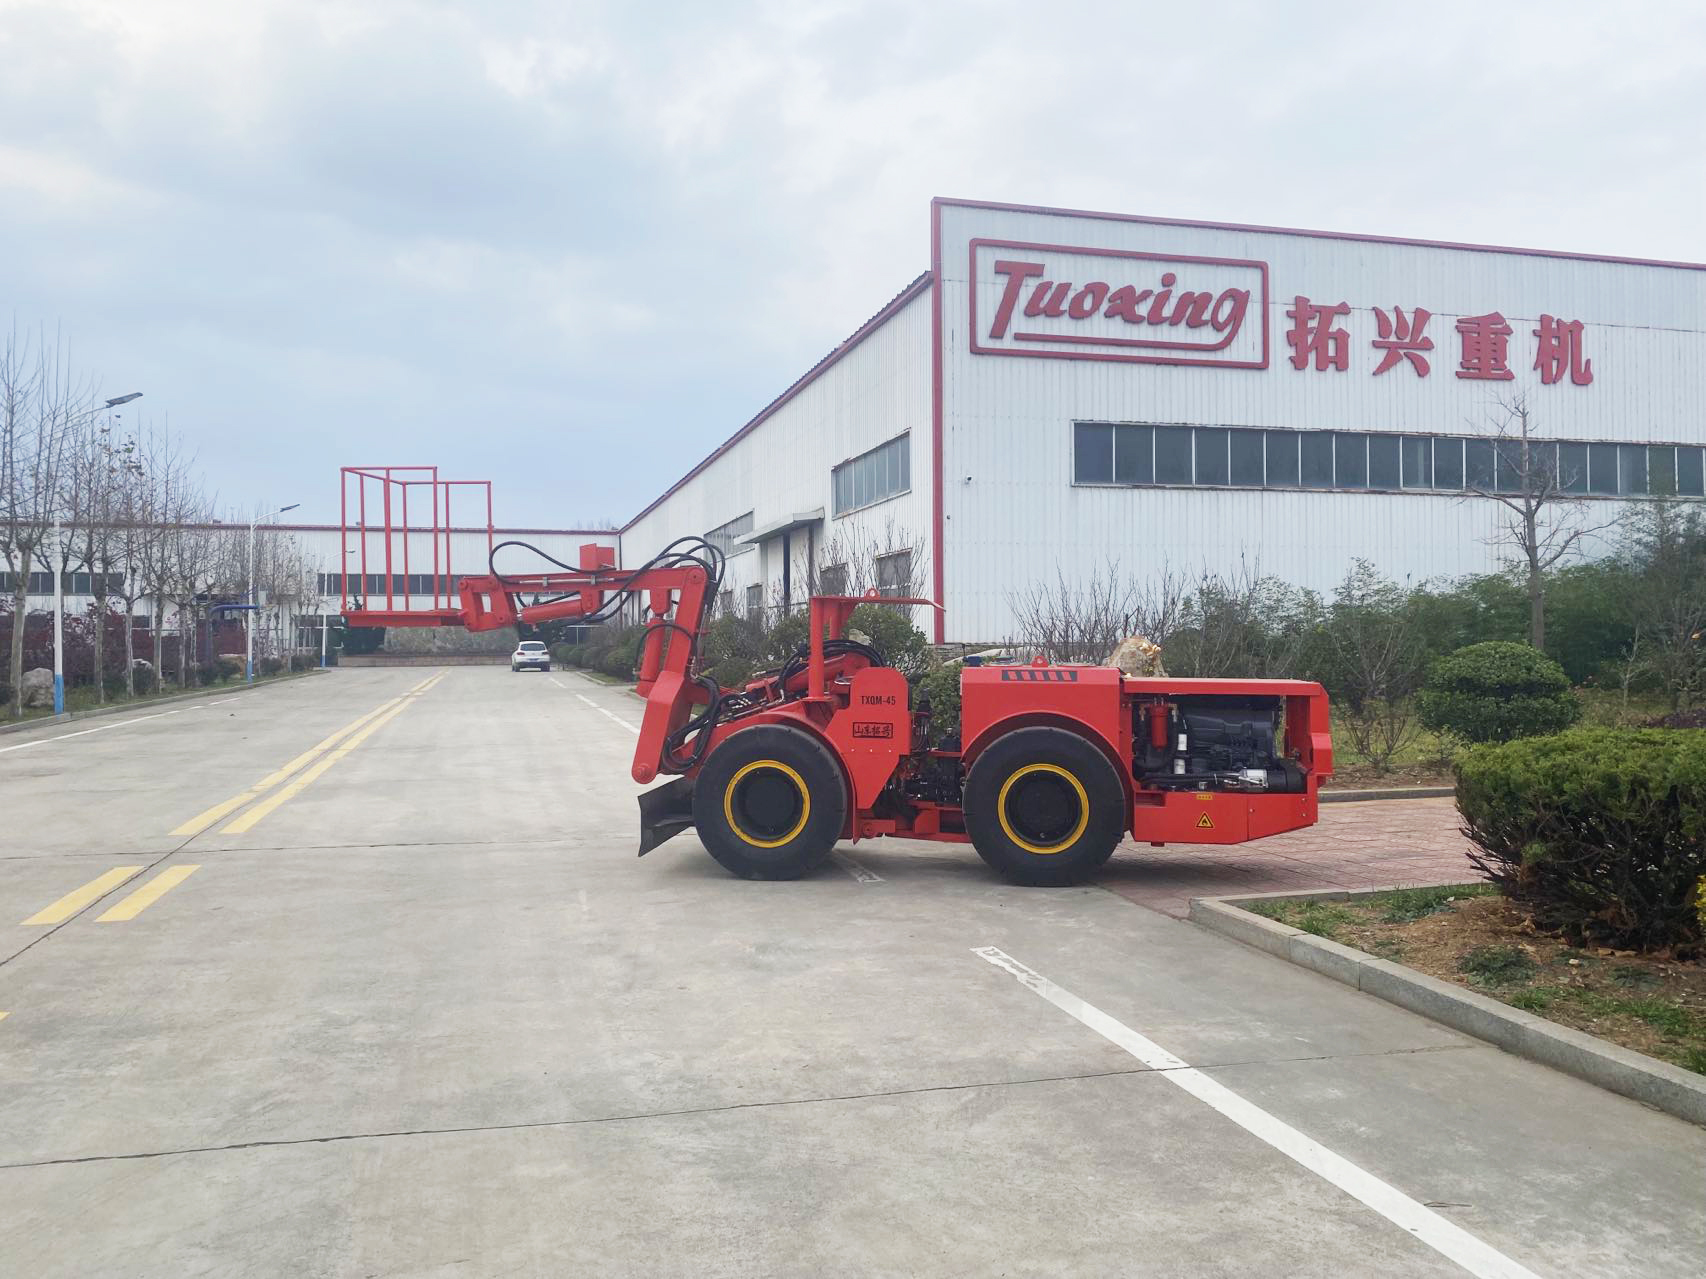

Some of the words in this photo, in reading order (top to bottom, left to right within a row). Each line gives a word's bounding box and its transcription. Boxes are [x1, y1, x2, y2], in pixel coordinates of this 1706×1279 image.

[989, 260, 1250, 351] Tuoxing
[1287, 296, 1594, 385] 拓兴重机
